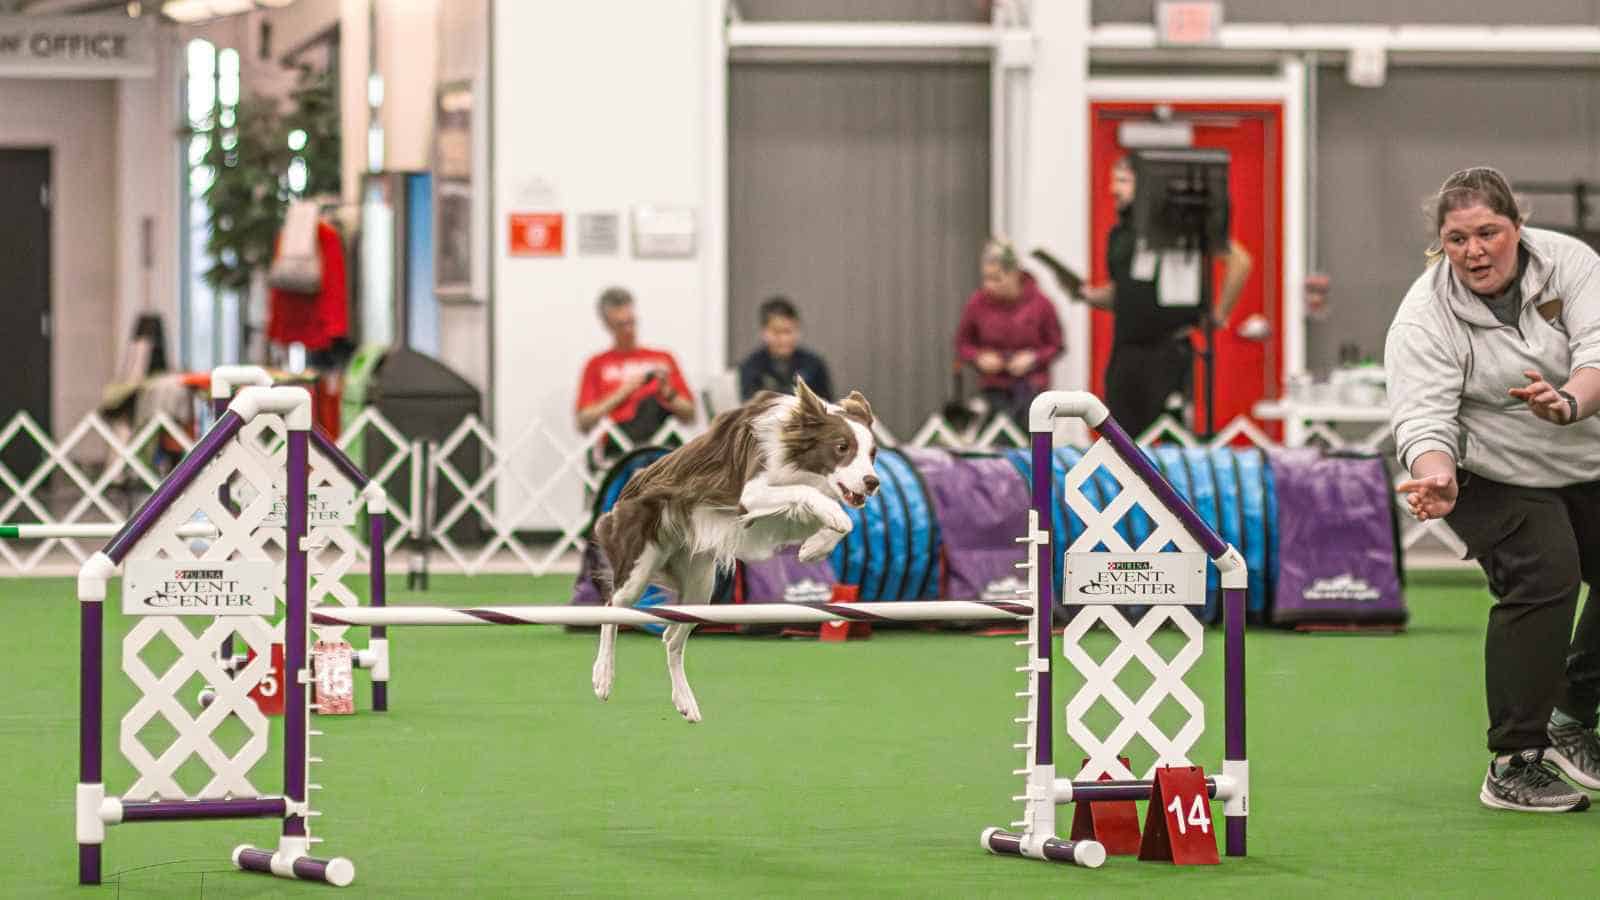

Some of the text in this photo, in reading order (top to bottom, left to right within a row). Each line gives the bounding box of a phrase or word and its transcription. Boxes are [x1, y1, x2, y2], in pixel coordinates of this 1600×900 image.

[30, 32, 127, 58] OFFICE
[1114, 562, 1150, 570] PURINA
[1098, 571, 1165, 582] EVENT
[164, 581, 239, 593] EVENT
[1079, 583, 1176, 595] CENTER
[144, 593, 252, 607] CENTER
[1167, 794, 1211, 835] 14
